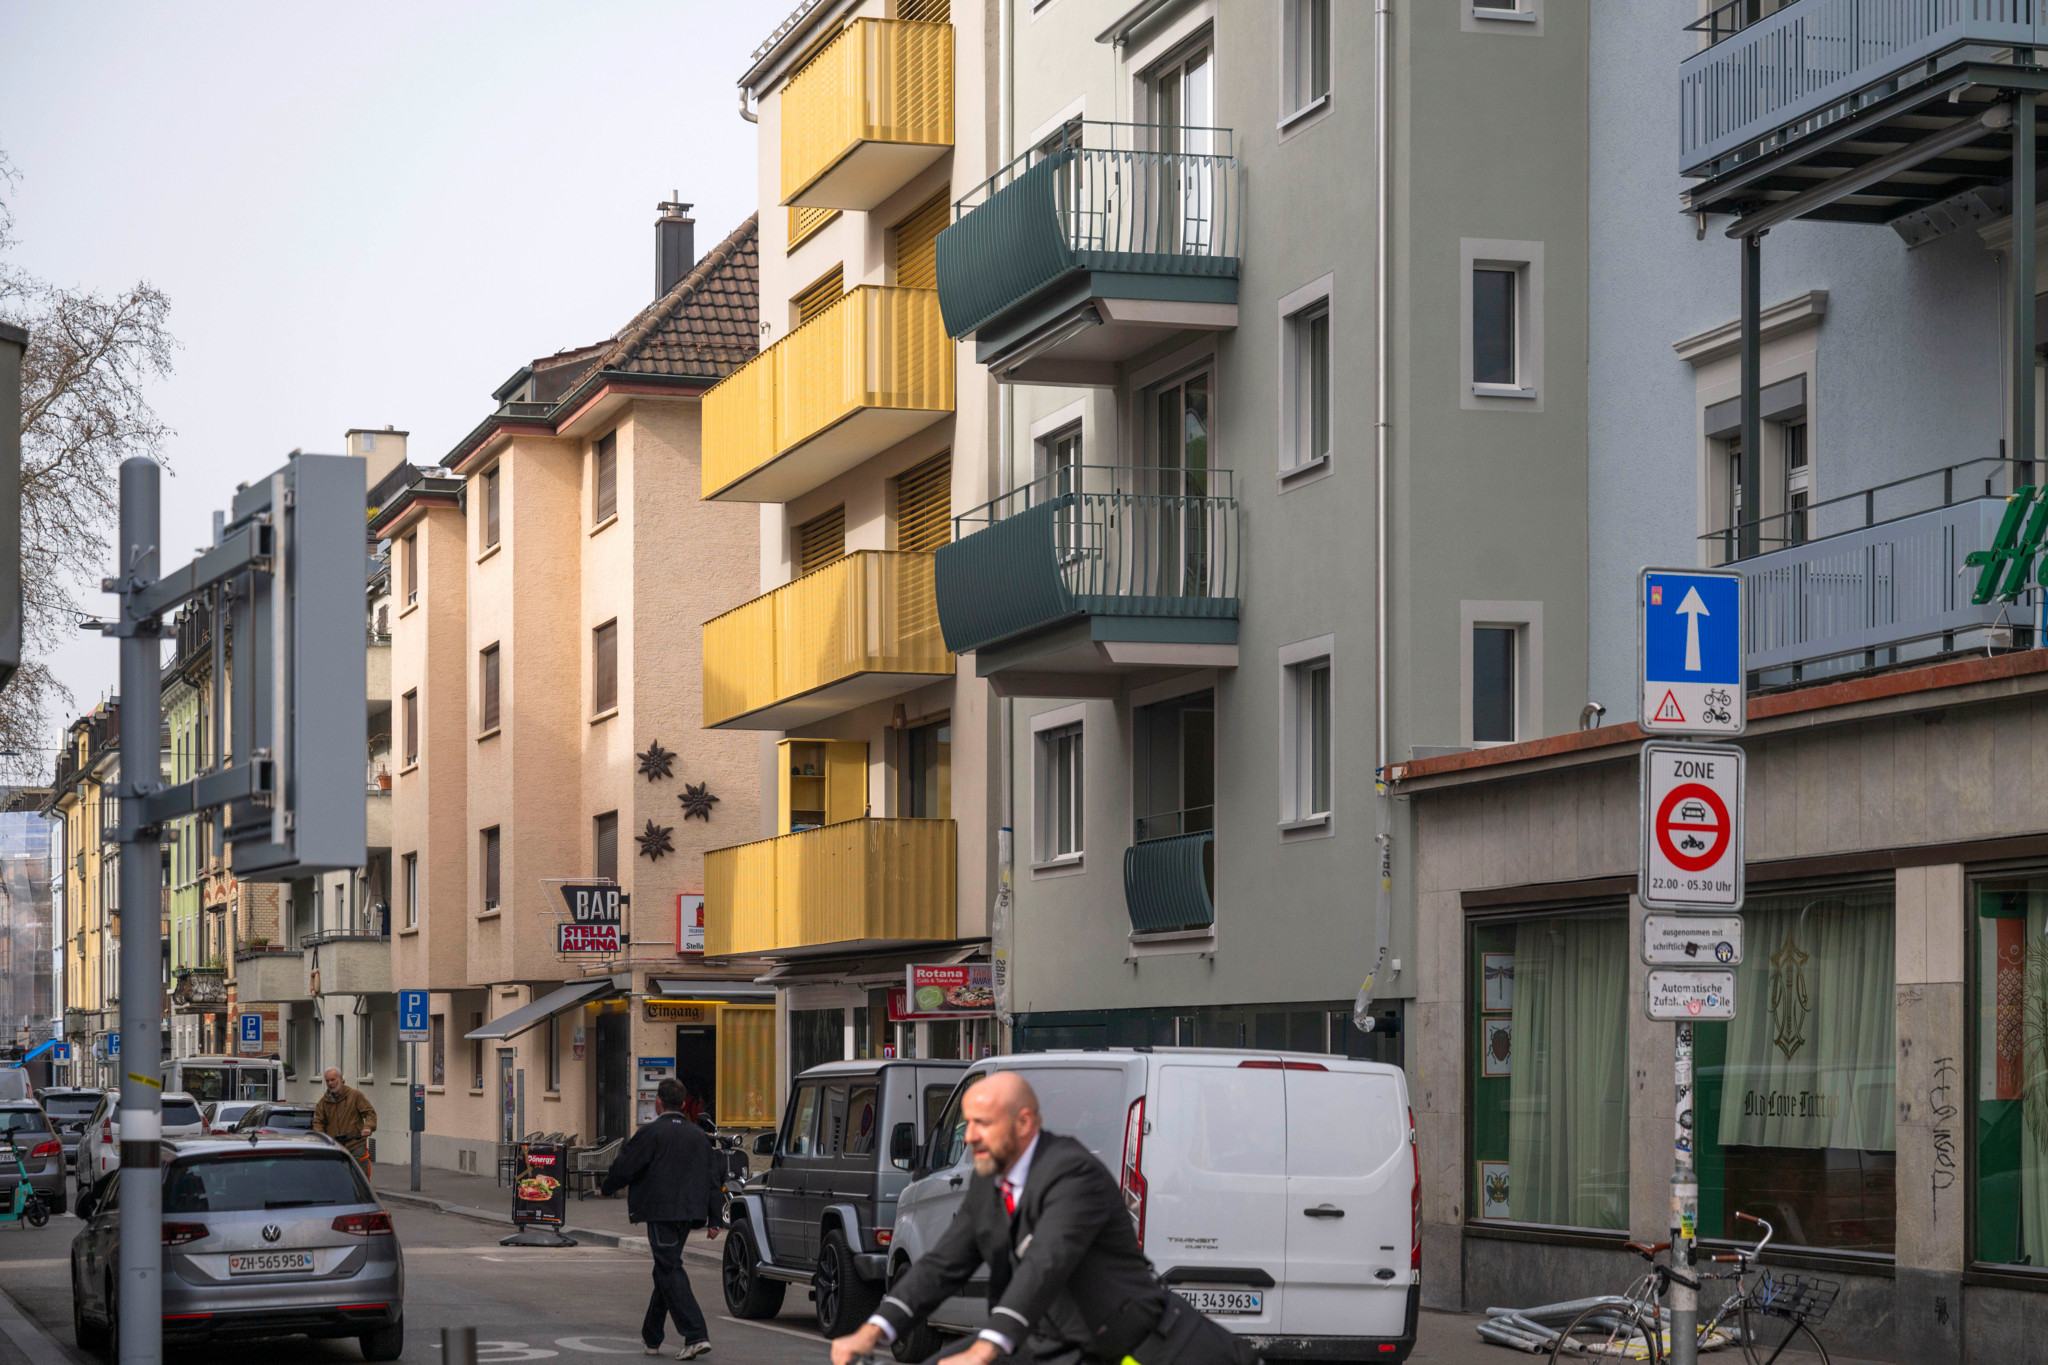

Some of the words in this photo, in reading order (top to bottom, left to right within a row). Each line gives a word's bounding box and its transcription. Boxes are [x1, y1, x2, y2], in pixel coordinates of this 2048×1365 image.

[1674, 760, 1715, 779] ZONE
[1652, 878, 1678, 890] 22.00
[1687, 879, 1713, 891] 05.30
[1716, 881, 1732, 892] Uhr
[576, 890, 620, 920] BAR
[564, 925, 617, 938] STELLA
[1662, 929, 1710, 938] ausgenommen
[1712, 929, 1723, 937] mit
[562, 938, 618, 951] ALPINA
[685, 942, 704, 950] Stella
[916, 969, 964, 978] Rotana
[972, 977, 991, 985] AWAY
[1661, 983, 1723, 993] Automatische
[648, 1003, 700, 1020] Eingang
[1768, 1090, 1797, 1117] Love
[1799, 1091, 1840, 1117] Tattoo
